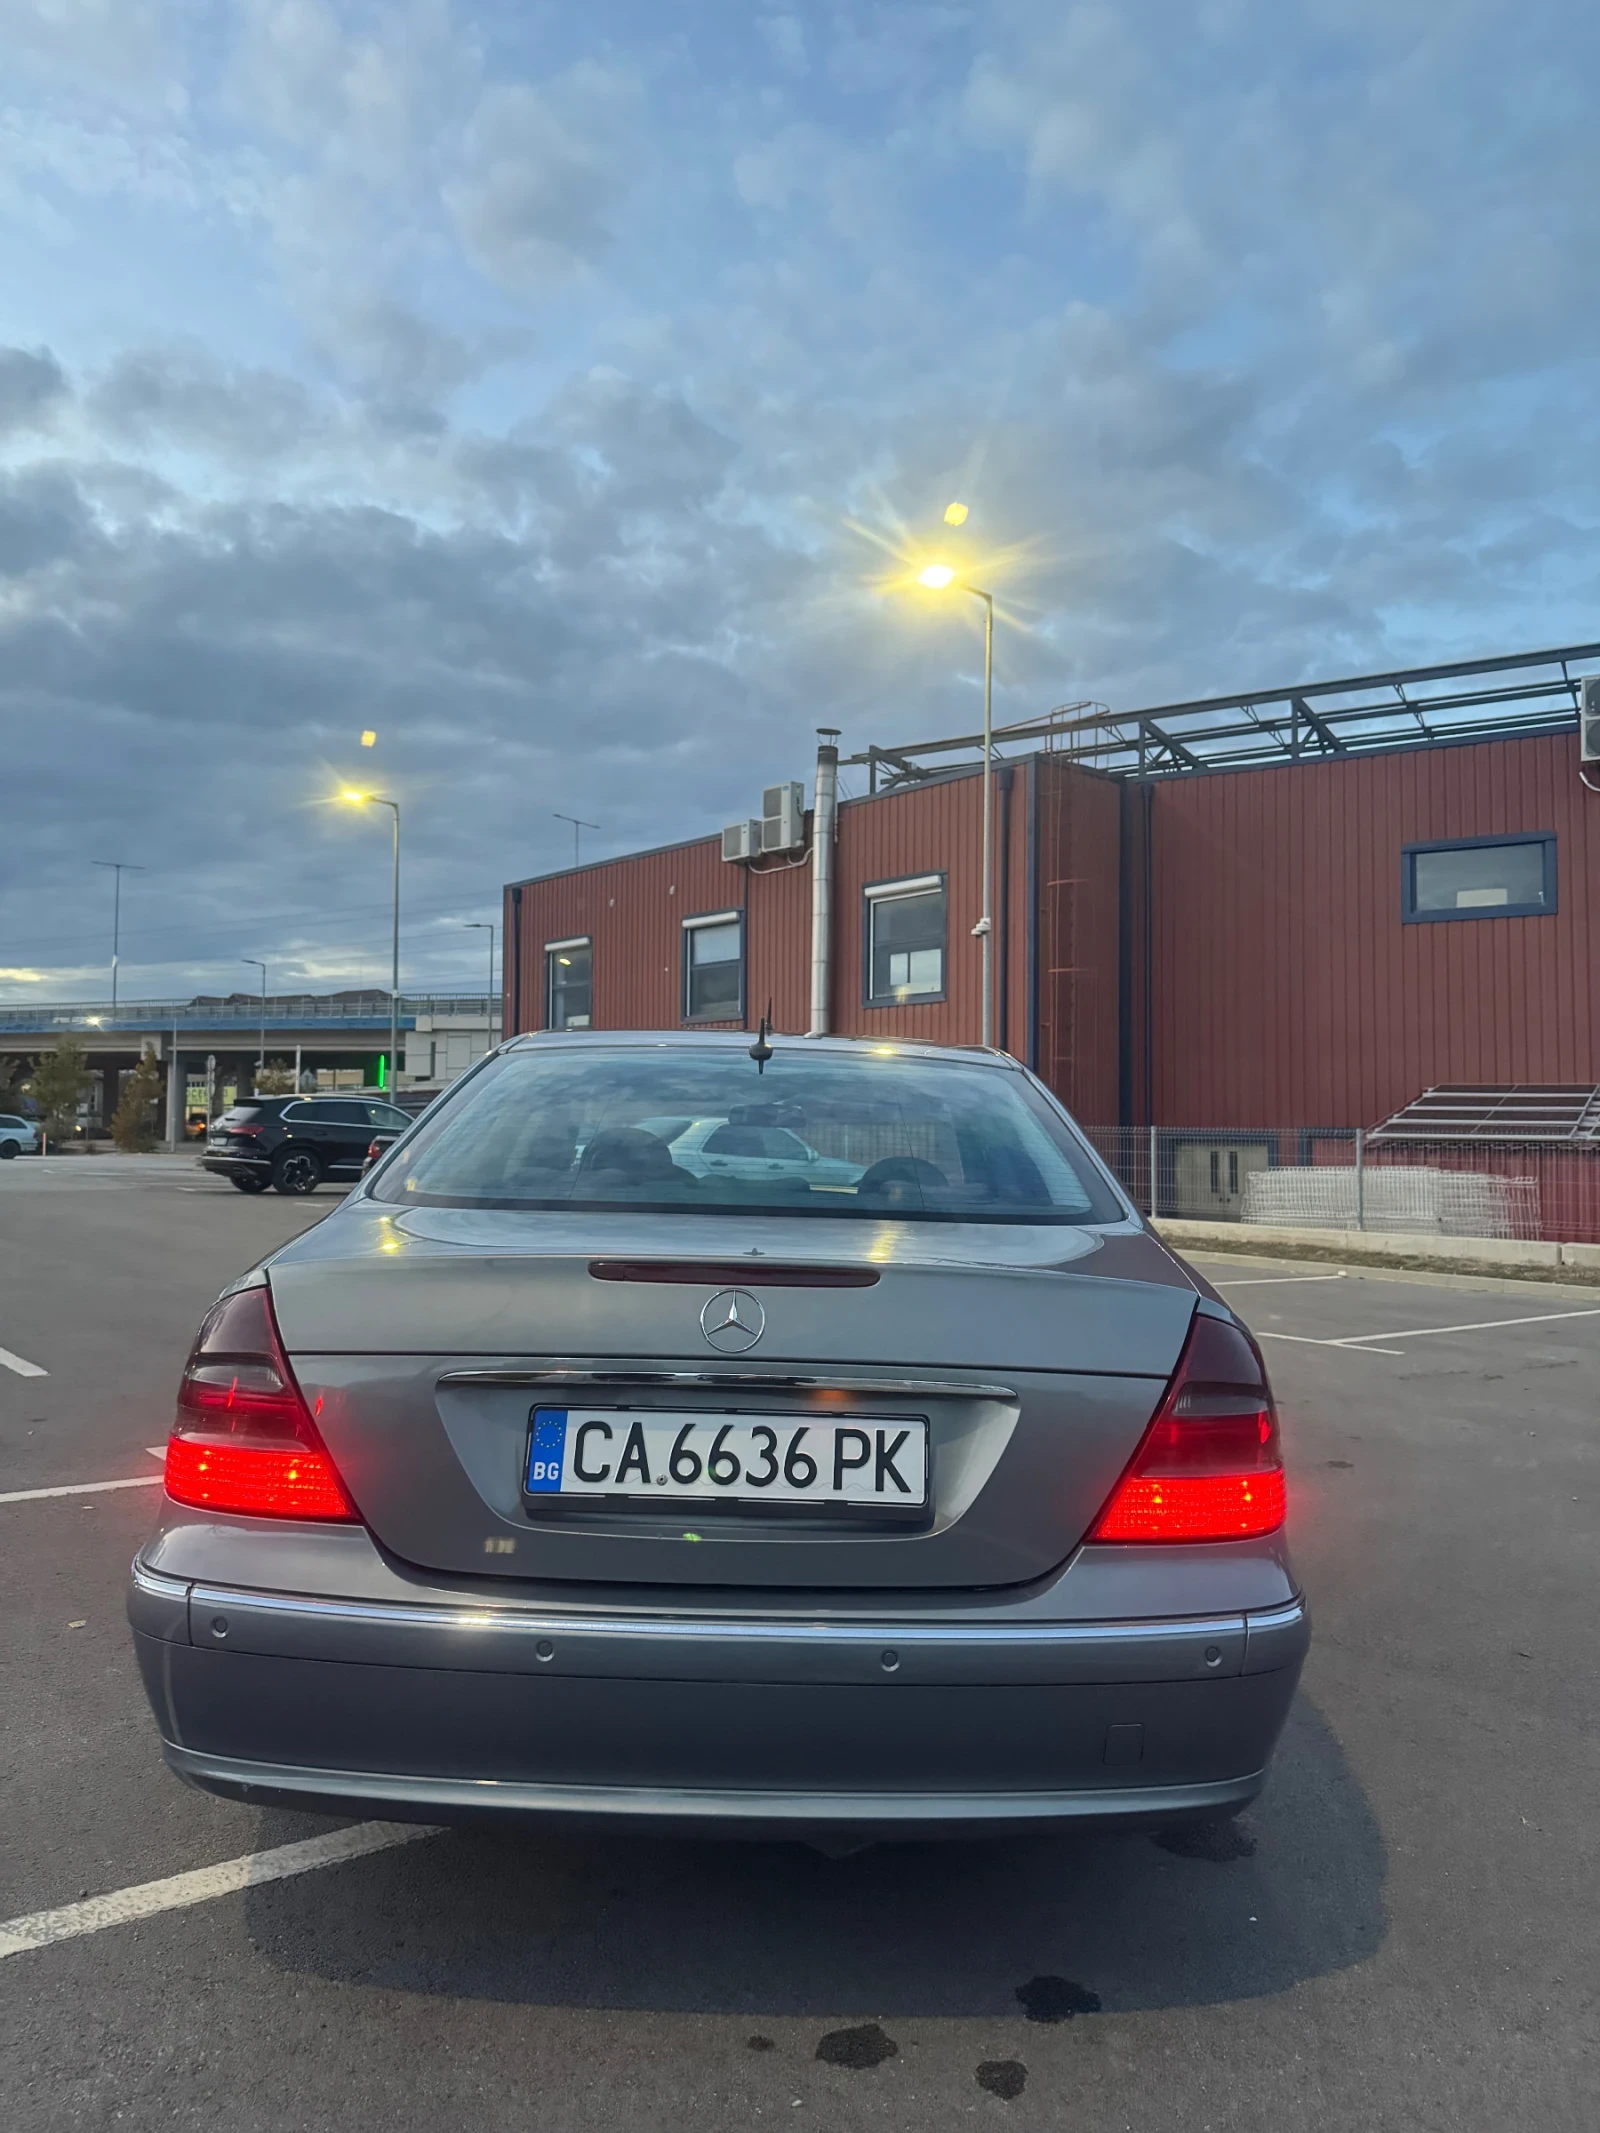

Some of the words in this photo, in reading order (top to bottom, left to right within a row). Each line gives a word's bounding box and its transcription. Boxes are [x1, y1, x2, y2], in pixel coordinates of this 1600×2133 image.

[533, 1461, 560, 1481] BG
[573, 1420, 652, 1484] CA
[668, 1423, 818, 1489] 6636
[832, 1427, 912, 1493] PK
